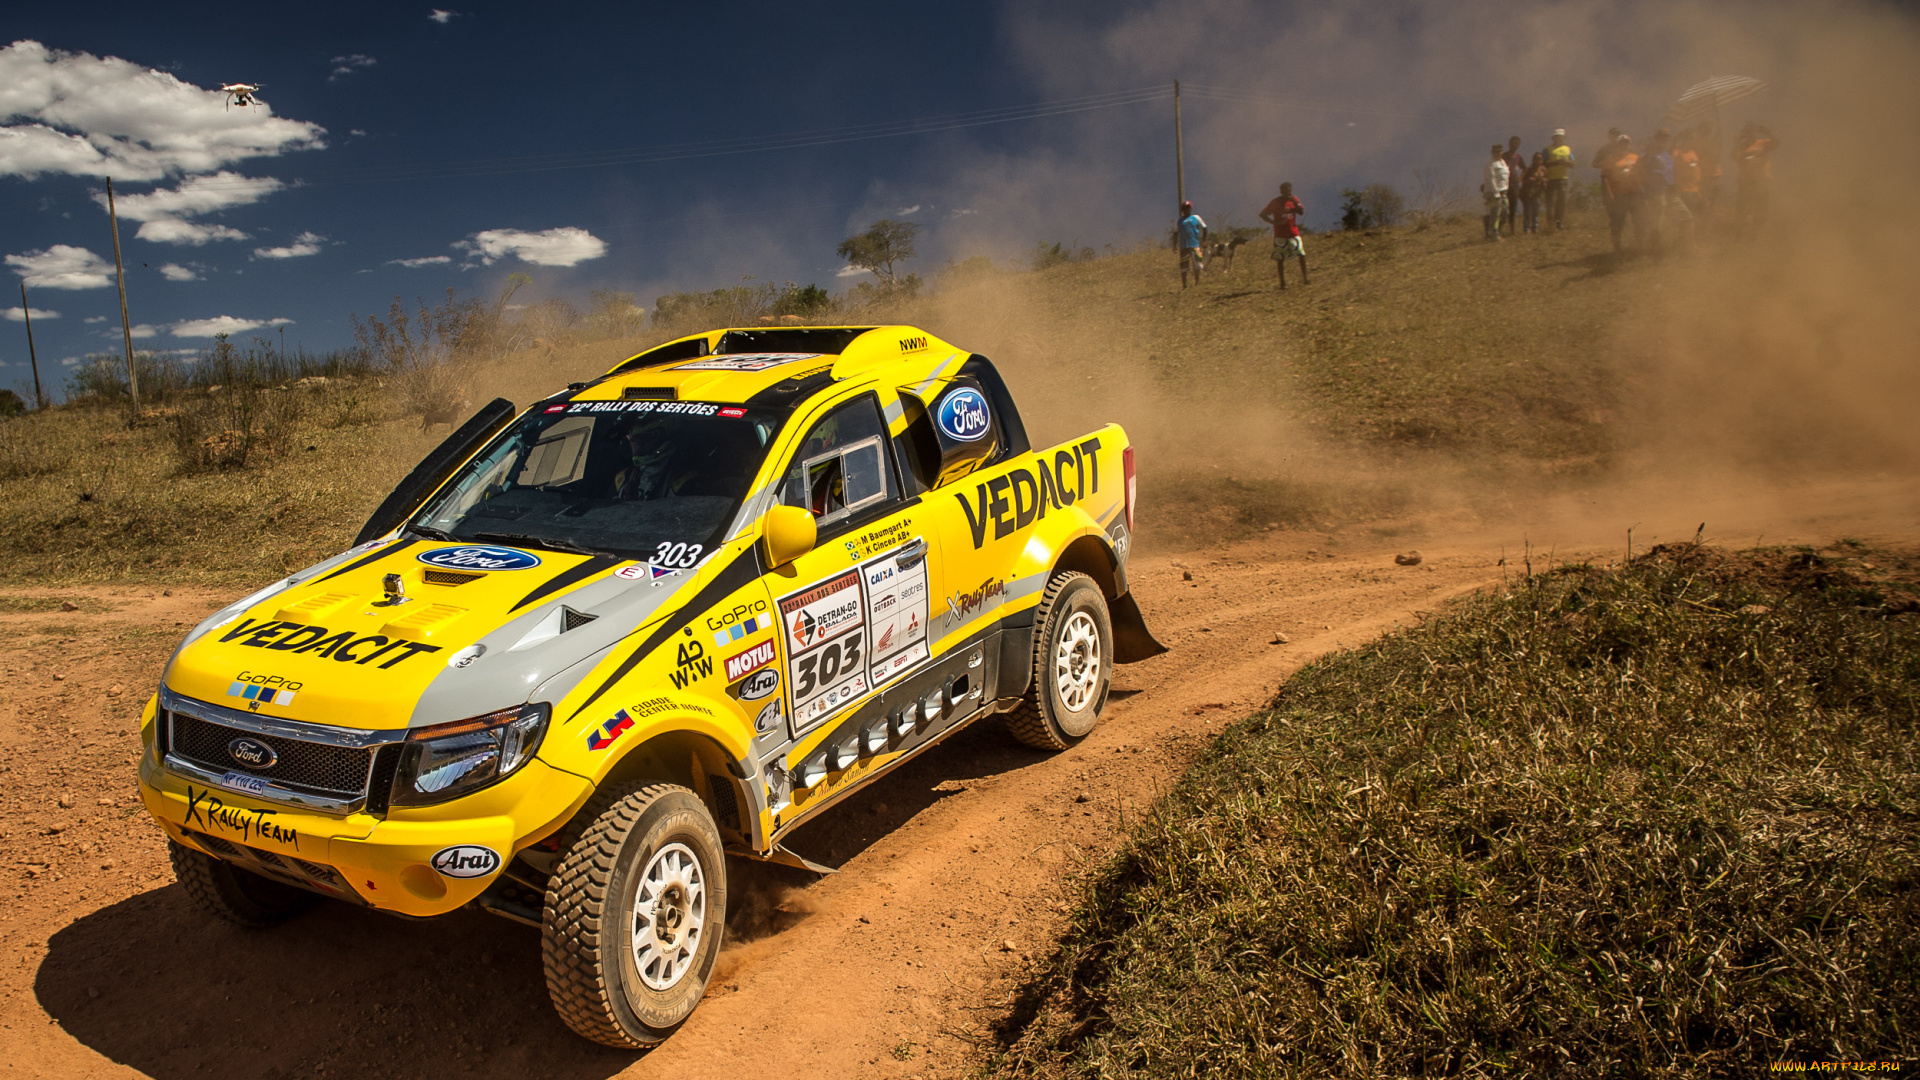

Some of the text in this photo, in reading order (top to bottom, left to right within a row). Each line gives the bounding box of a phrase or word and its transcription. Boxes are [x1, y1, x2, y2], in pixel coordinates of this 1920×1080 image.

[899, 336, 928, 351] NWM
[591, 401, 632, 412] RALLY
[628, 401, 656, 412] DOS
[656, 402, 719, 416] SERTÕES
[953, 395, 986, 434] Ford
[954, 437, 1101, 550] VEDACIT
[861, 518, 912, 545] M Baumgart A+
[866, 531, 910, 554] K Cincea AB+
[432, 549, 522, 568] Ford
[648, 541, 703, 568] 303
[620, 567, 639, 577] E
[871, 568, 893, 585] CAIXA
[795, 593, 817, 609] RALLY
[816, 587, 830, 599] DOS
[873, 598, 896, 613] OUTBACK
[706, 600, 767, 631] GoPro
[817, 600, 857, 626] DETRAN-GO
[825, 611, 857, 628] BALADA
[218, 618, 444, 670] VEDACIT
[728, 641, 775, 680] MOTUL
[796, 631, 863, 700] 303
[236, 671, 303, 692] GoPro
[740, 671, 775, 697] Arai
[631, 696, 674, 712] CIDADE
[639, 703, 716, 718] CENTER NORTE
[235, 741, 263, 764] Ford
[440, 849, 493, 873] Arai
